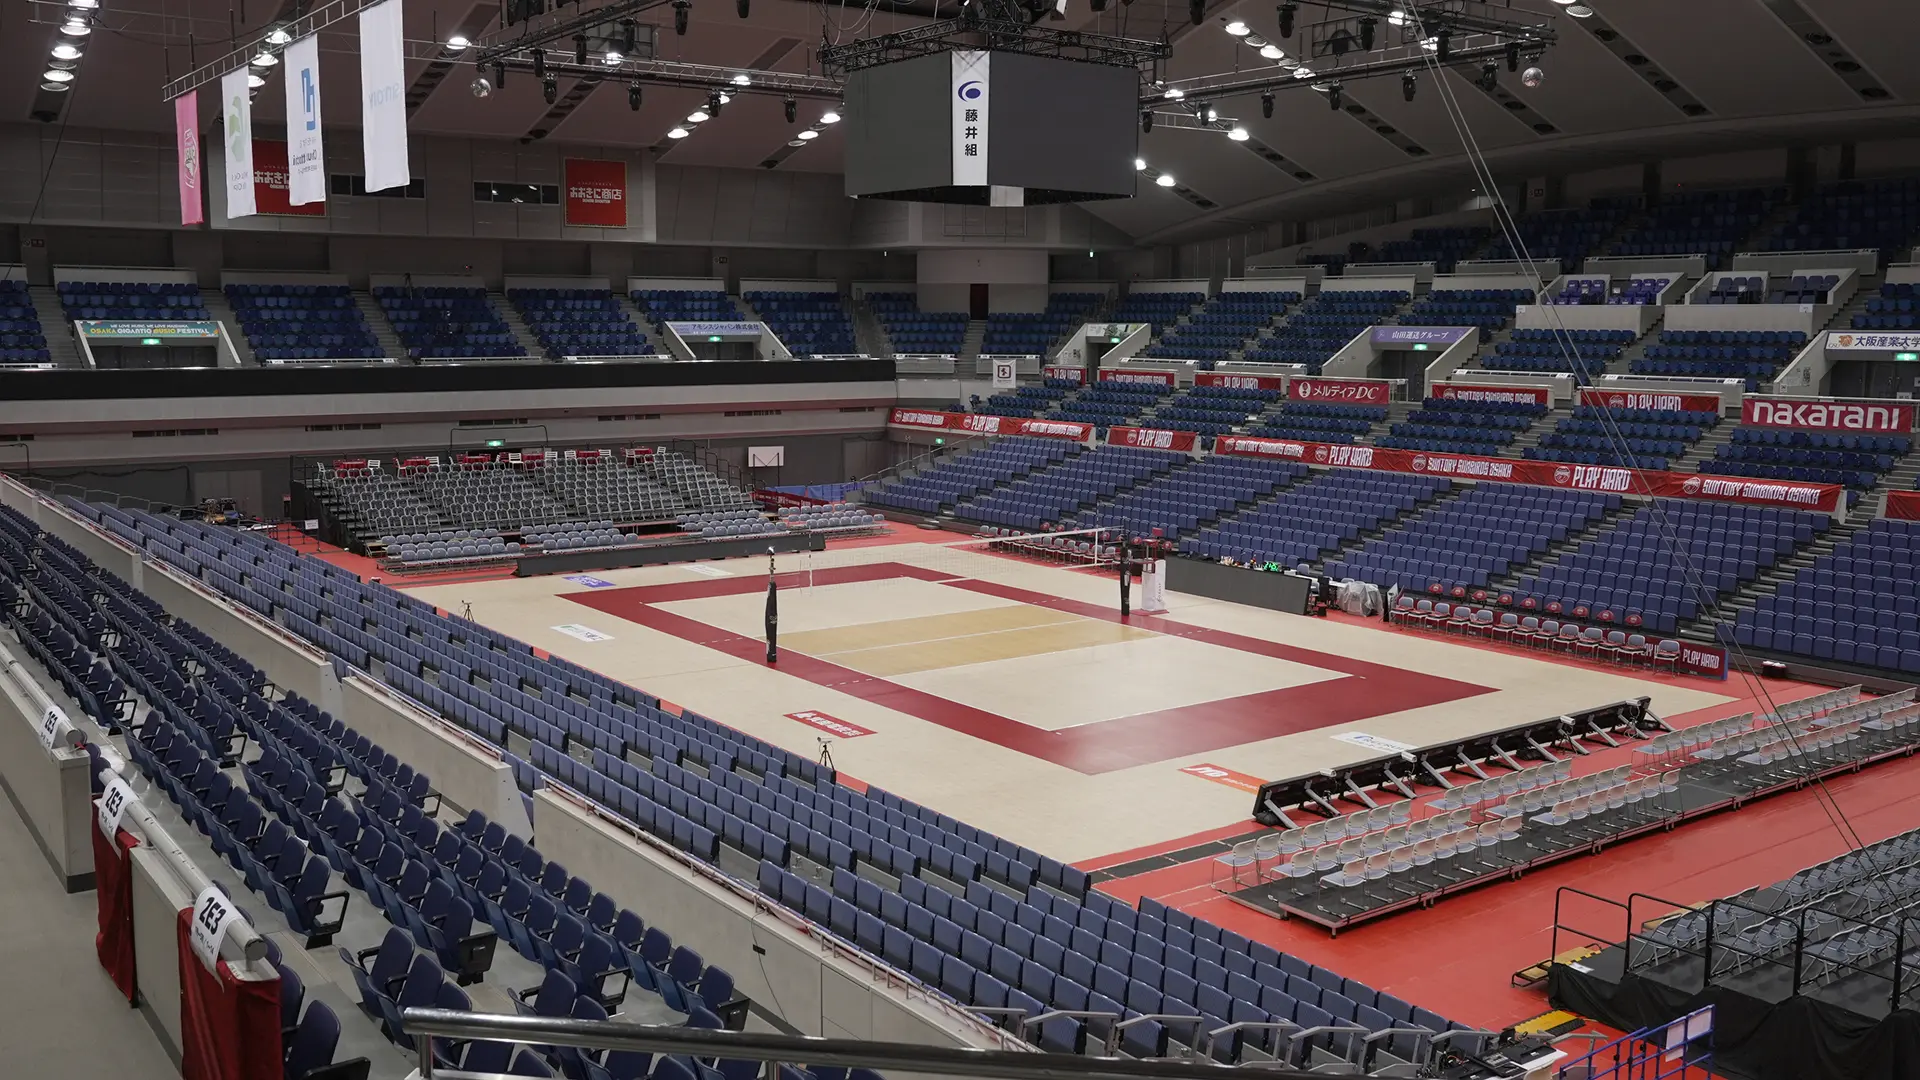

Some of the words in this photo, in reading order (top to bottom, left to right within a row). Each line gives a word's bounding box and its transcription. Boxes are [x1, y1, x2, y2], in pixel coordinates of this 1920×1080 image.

[964, 108, 978, 156] 藤井組
[569, 186, 622, 200] おおきに商店
[1854, 335, 1920, 348] 大阪産業大学
[1137, 429, 1156, 446] PLAY
[1153, 430, 1173, 448] HARD
[1328, 445, 1352, 466] PLAY
[1350, 447, 1373, 467] HARD
[1427, 457, 1458, 473] SUNTORY
[1456, 459, 1489, 475] SUNBIRDS
[1489, 461, 1513, 478] OSAKA
[1571, 465, 1600, 489] PLAY
[1599, 467, 1632, 491] HARD
[1702, 479, 1743, 495] SUNTORY
[1742, 482, 1789, 501] SUNBIRDS
[1786, 487, 1821, 505] OSAKA
[1682, 648, 1701, 664] PLAY
[1700, 652, 1720, 669] HARD
[44, 710, 58, 735] 2E3
[105, 786, 123, 818] 2E3
[199, 896, 227, 936] 2E3
